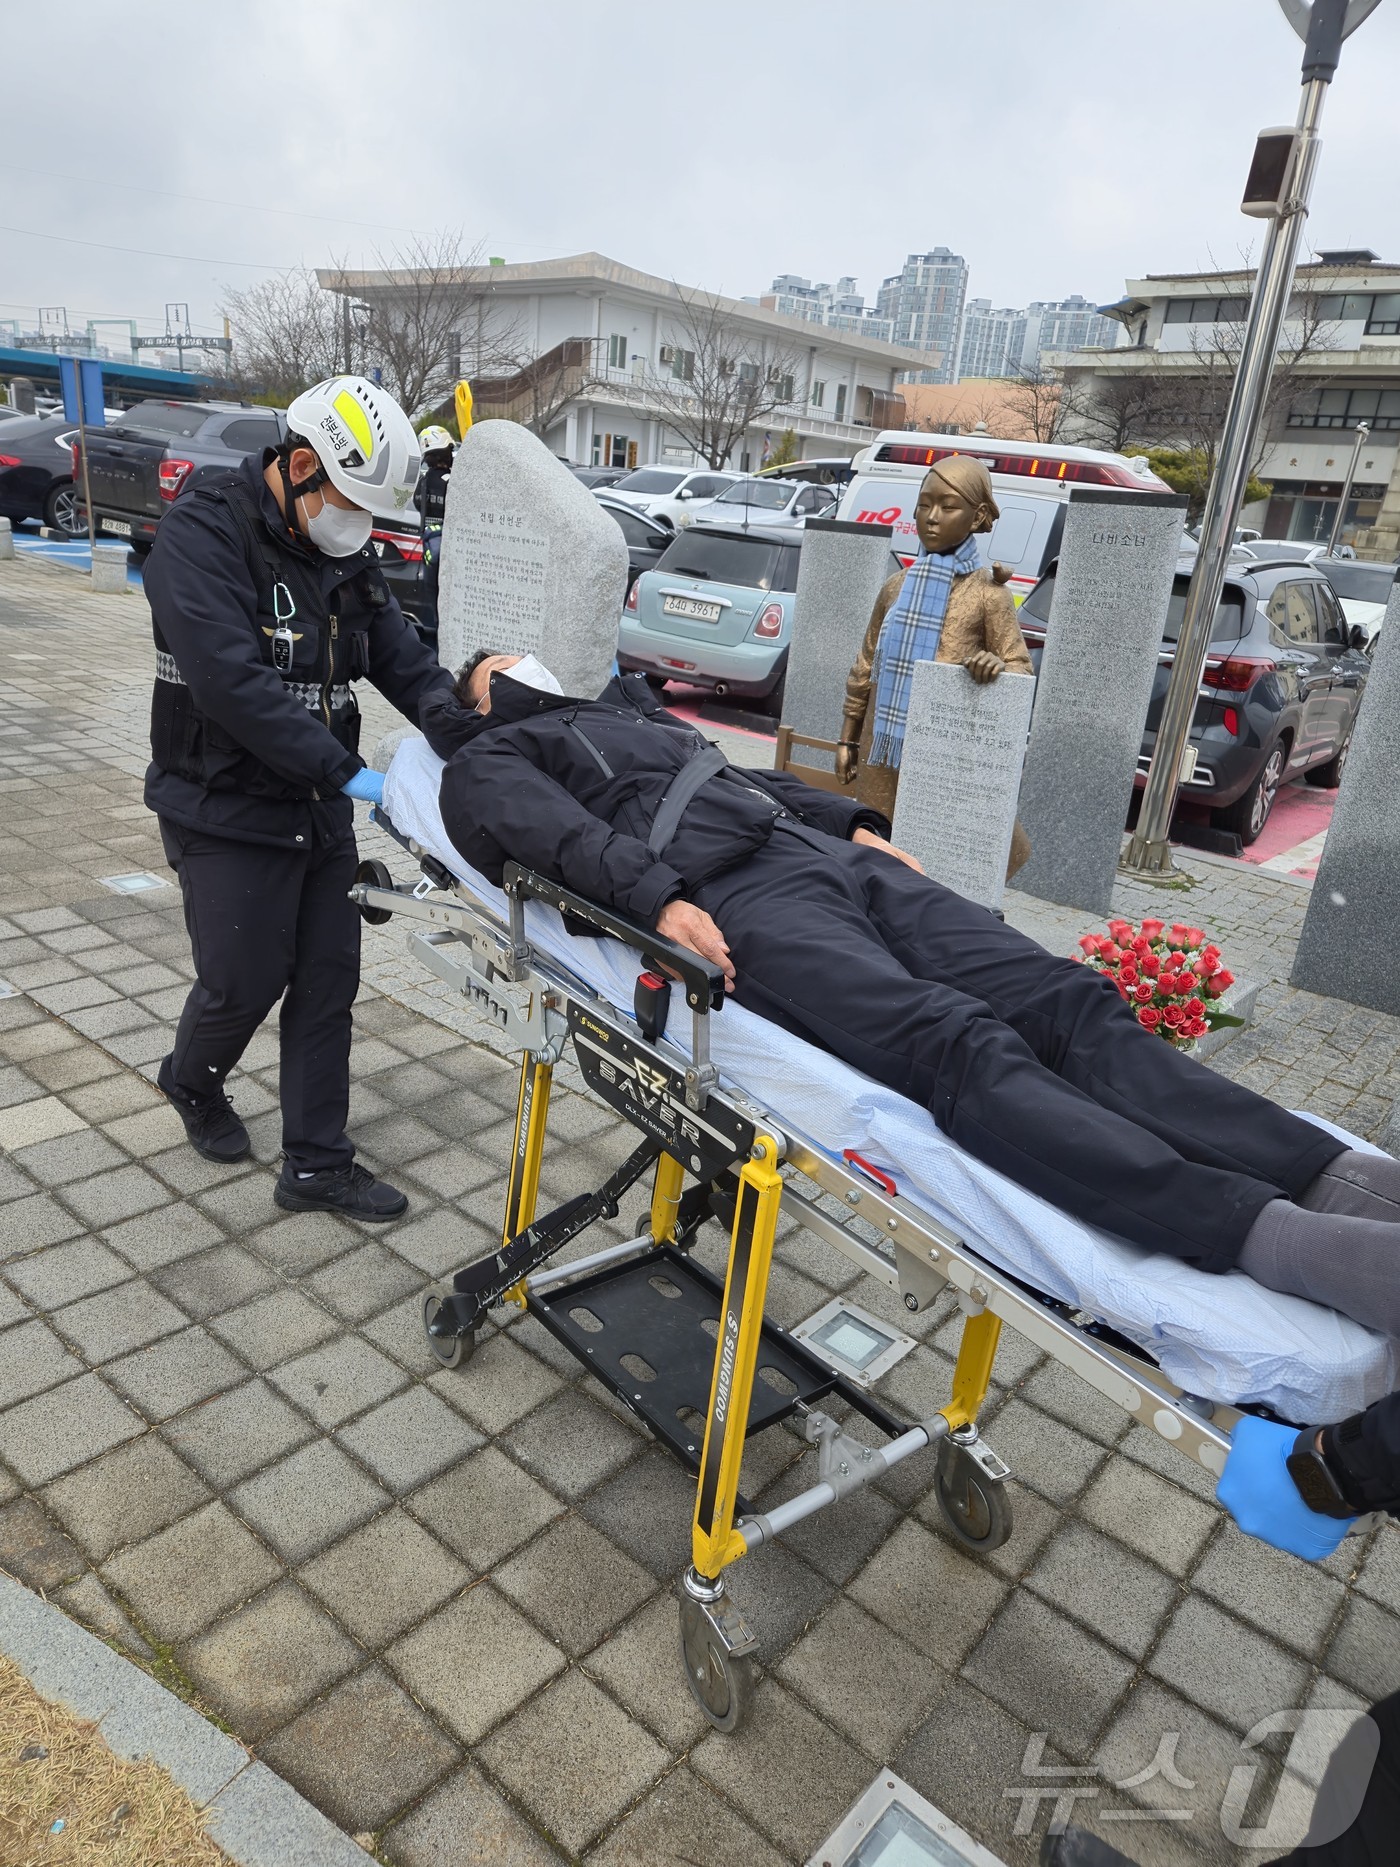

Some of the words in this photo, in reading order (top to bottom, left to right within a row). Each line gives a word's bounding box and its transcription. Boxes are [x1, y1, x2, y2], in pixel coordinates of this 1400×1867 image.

[320, 414, 349, 451] 전북소방
[480, 512, 494, 524] 건립
[499, 514, 522, 528] 선언문
[1092, 533, 1146, 547] 나비소녀
[690, 603, 713, 617] 3961
[600, 1060, 701, 1148] SAVER
[518, 1096, 531, 1157] SUNGWOO
[648, 1120, 667, 1137] SAVER
[715, 1335, 735, 1422] SUNGWOO
